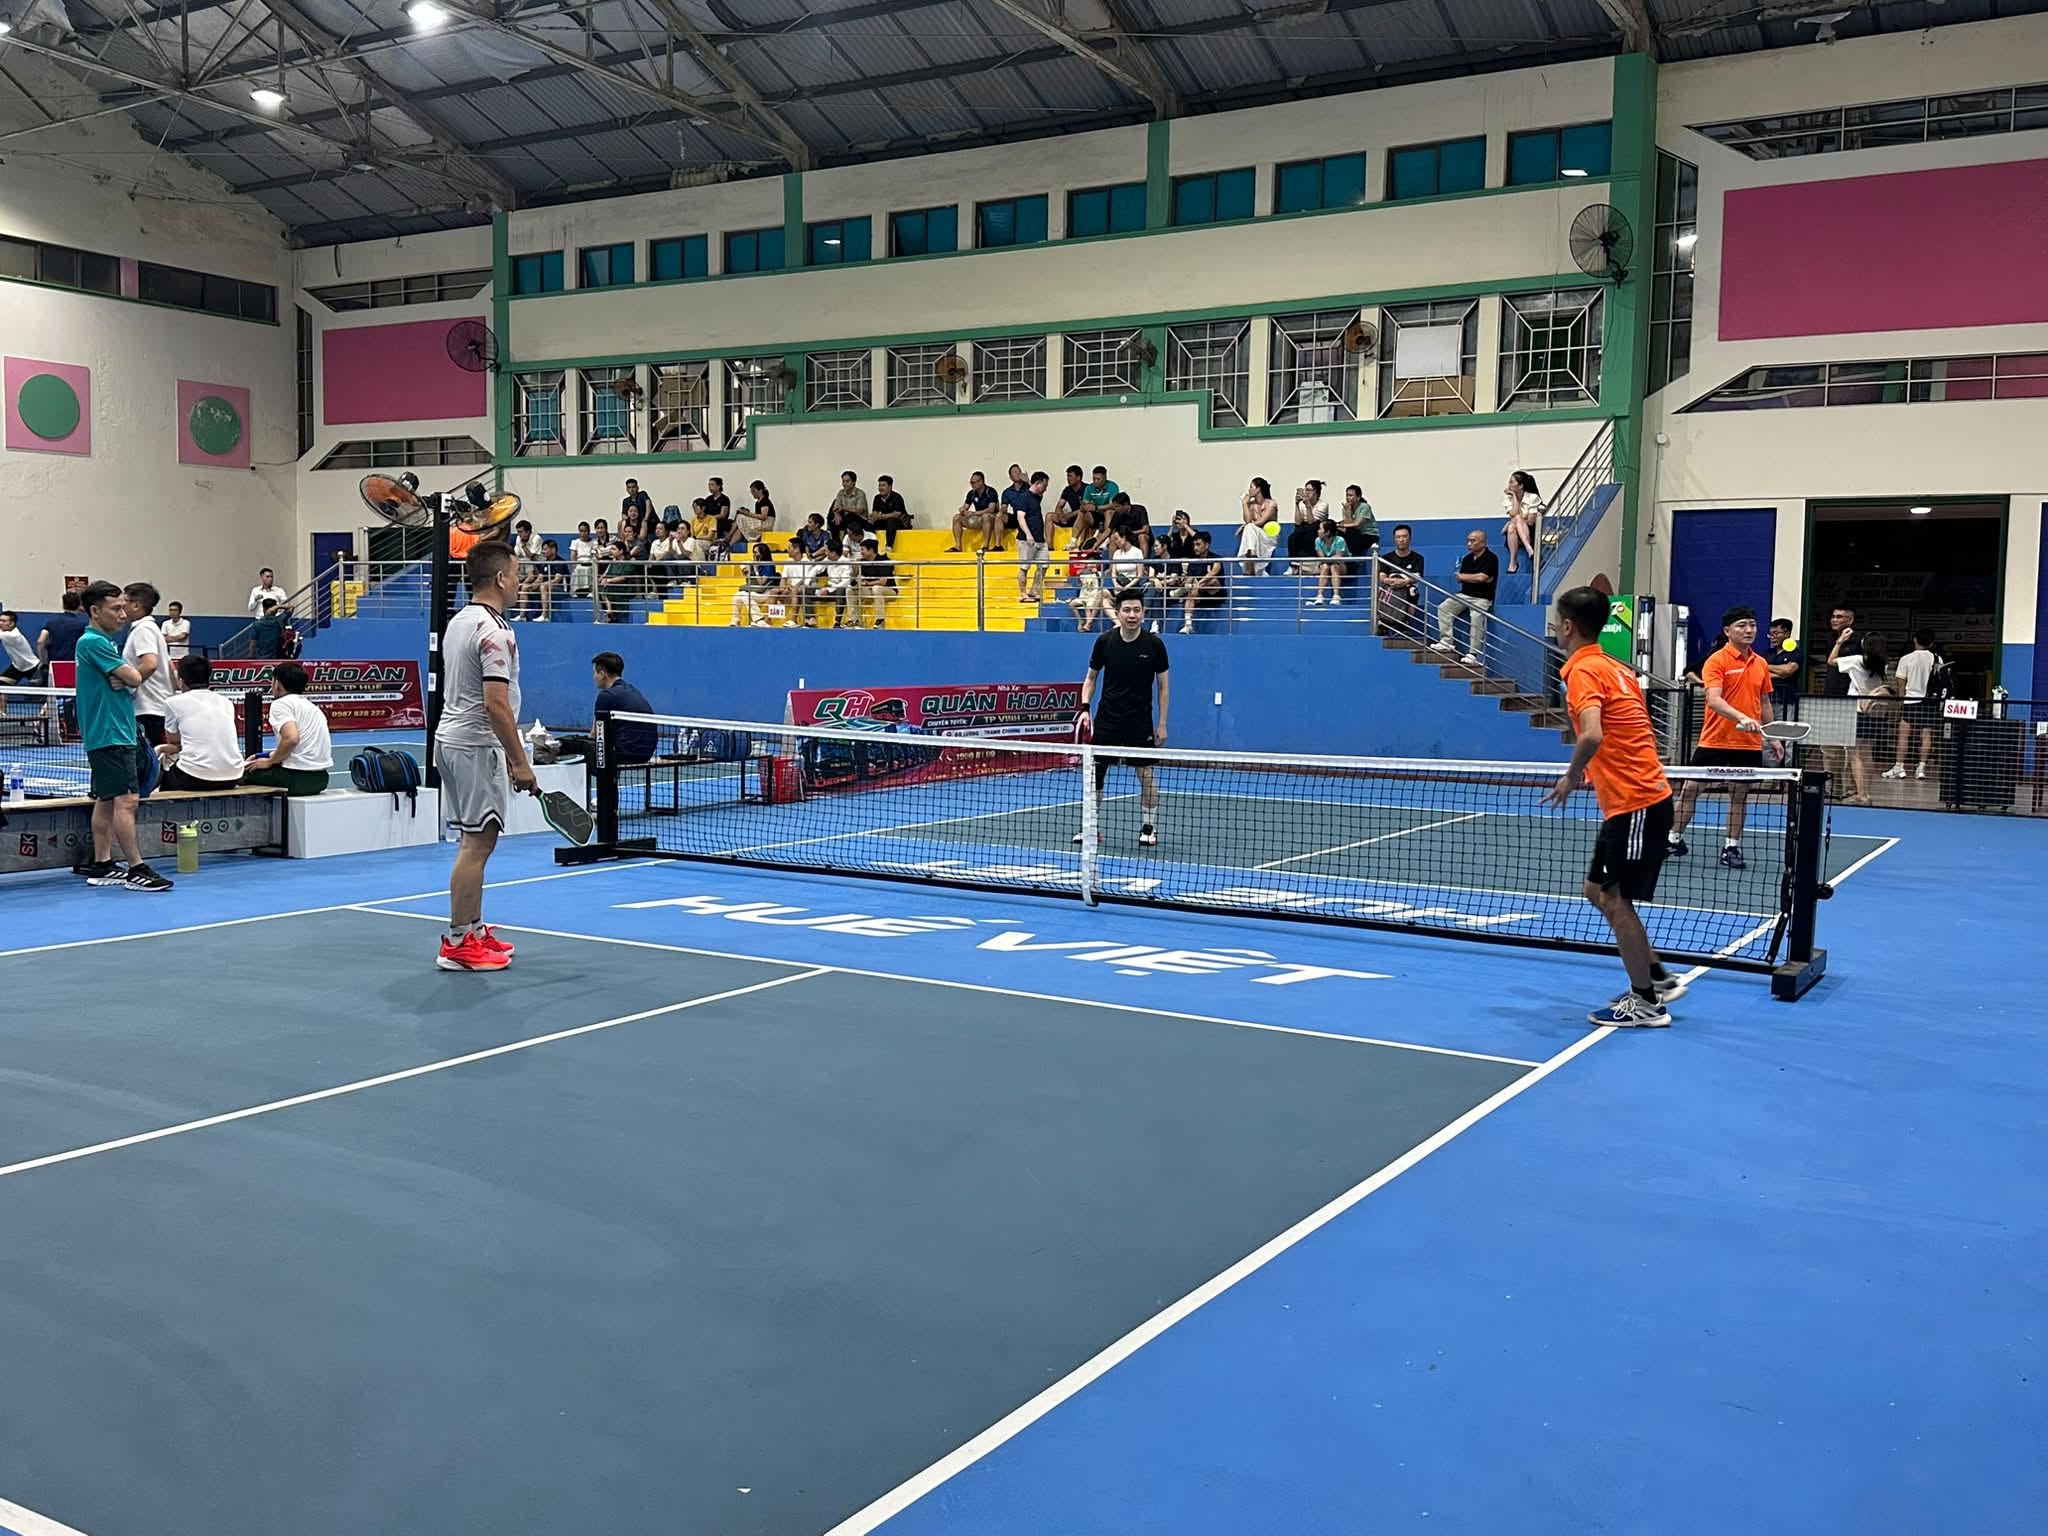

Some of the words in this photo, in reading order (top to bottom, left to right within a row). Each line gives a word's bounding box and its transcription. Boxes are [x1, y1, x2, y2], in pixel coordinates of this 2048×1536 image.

[209, 665, 275, 684] QUÂ
[313, 664, 406, 682] HOÀN
[921, 689, 998, 716] QUÂN
[1006, 687, 1078, 711] HOÀN
[1946, 703, 1967, 715] SÂN
[1970, 706, 1975, 715] 1
[983, 715, 997, 724] TP
[999, 714, 1021, 723] VINH
[1027, 713, 1039, 722] TP
[608, 895, 1024, 937] HUẾ
[976, 931, 1396, 985] VIỆT
